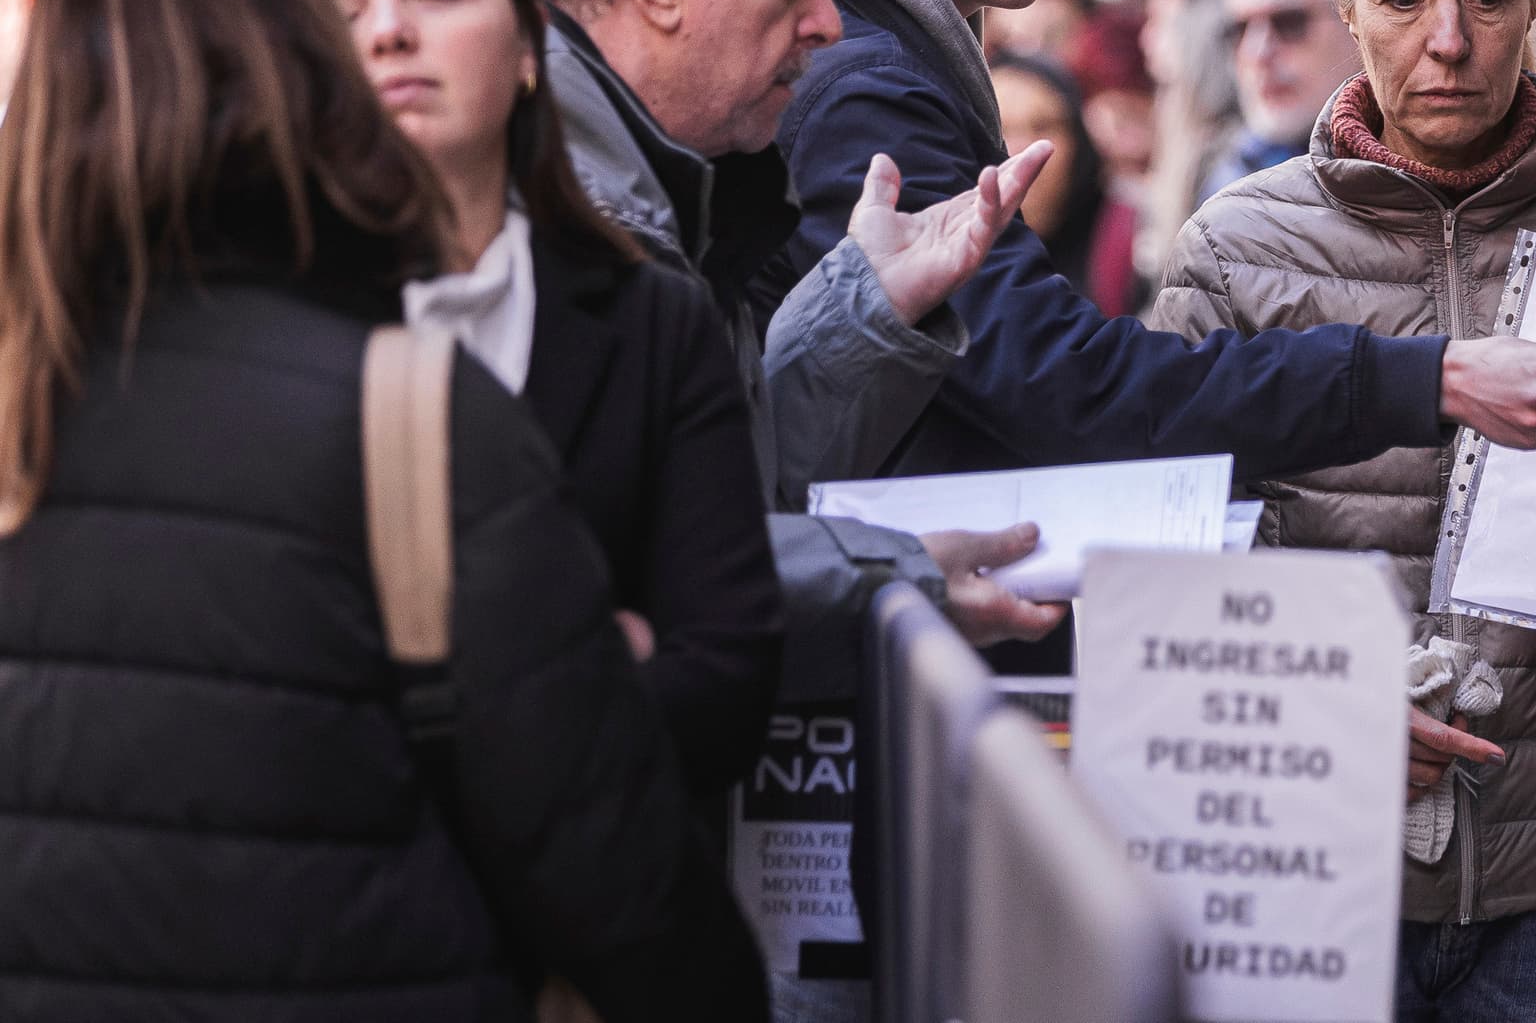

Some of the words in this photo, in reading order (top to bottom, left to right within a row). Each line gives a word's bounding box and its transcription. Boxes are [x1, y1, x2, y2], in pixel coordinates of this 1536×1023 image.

[1220, 592, 1274, 626] NO
[1141, 638, 1352, 678] INGRESAR
[1201, 692, 1281, 726] SIN
[1145, 738, 1334, 778] PERMISO
[1196, 790, 1273, 829] DEL
[761, 853, 842, 871] DENTRO
[1126, 837, 1338, 882] PERSONAL
[761, 876, 825, 894] MOVIL
[1203, 891, 1258, 928] DE
[1184, 942, 1347, 982] URIDAD
